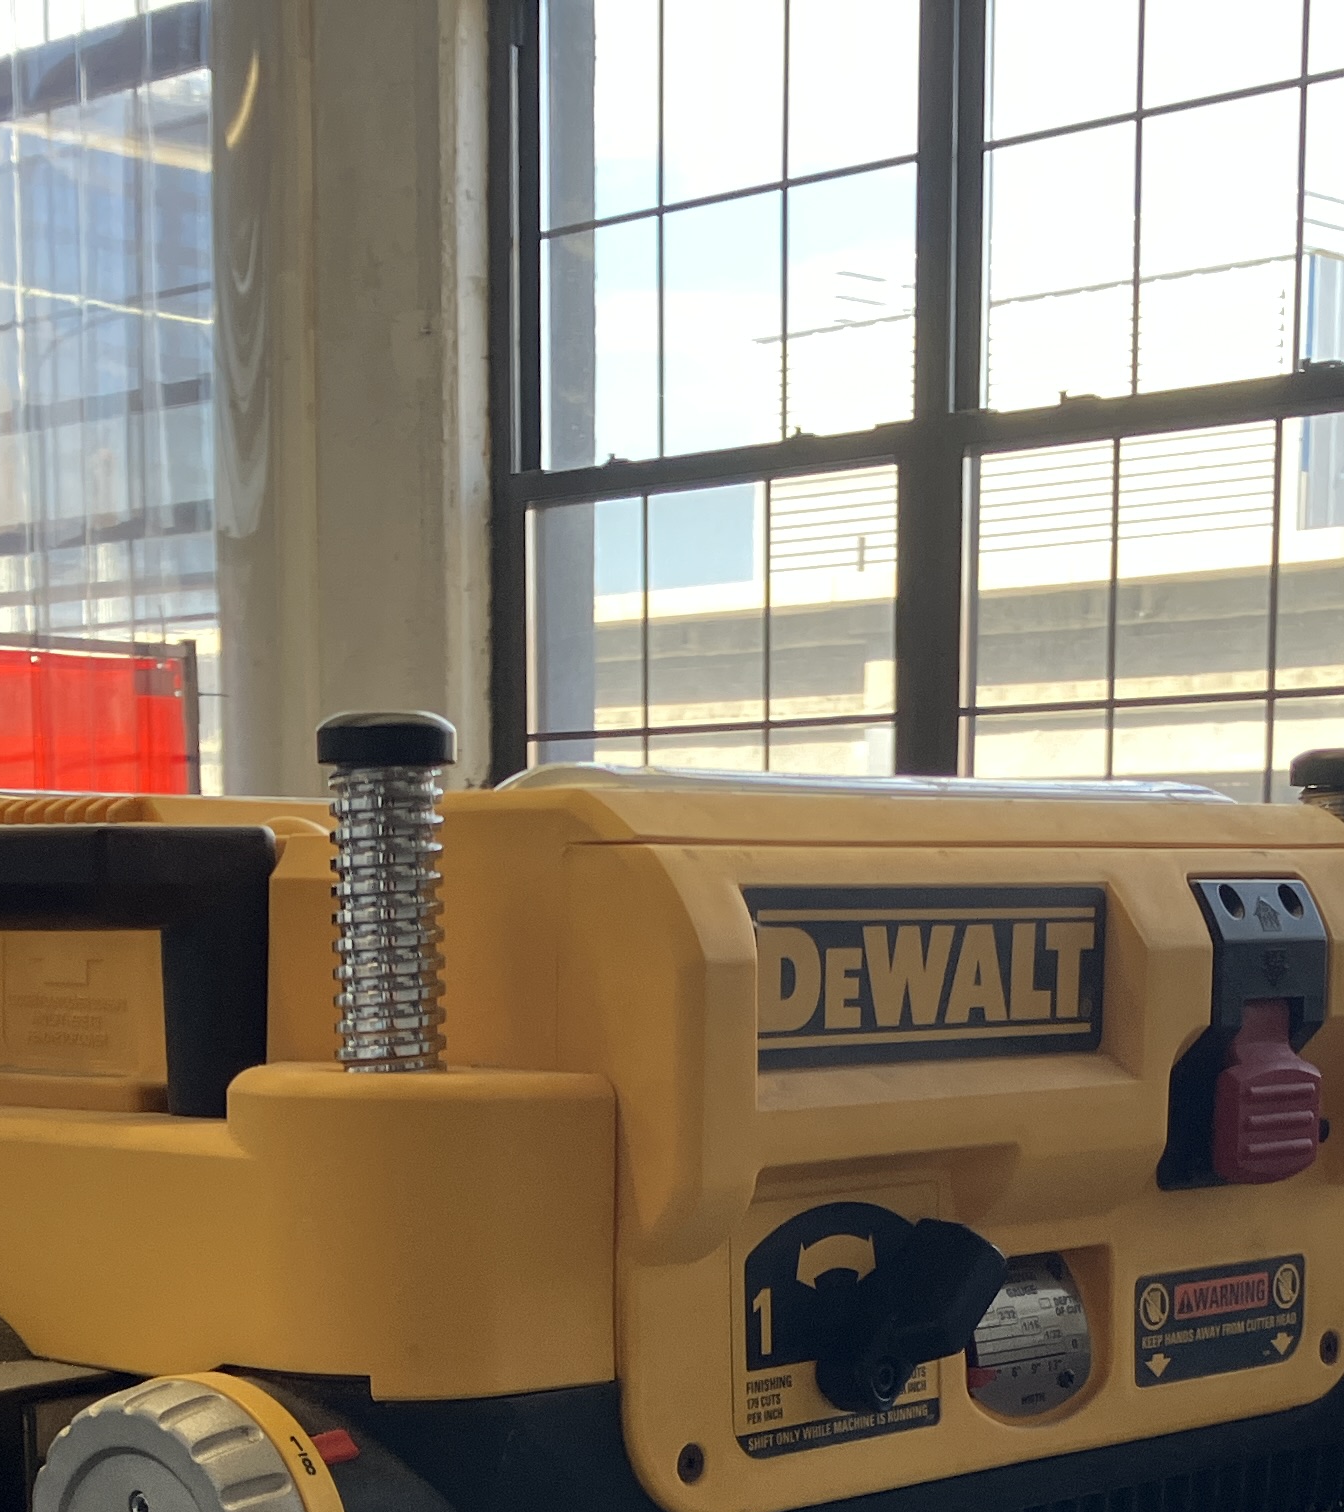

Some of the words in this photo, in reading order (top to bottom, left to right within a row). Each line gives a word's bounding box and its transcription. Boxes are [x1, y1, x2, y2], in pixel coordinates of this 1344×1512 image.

[1193, 1279, 1266, 1312] WARNING
[753, 1288, 772, 1355] 1
[1142, 1335, 1163, 1349] KEEP
[1165, 1329, 1195, 1346] HANDS
[1196, 1325, 1220, 1341] AWAY
[1222, 1320, 1245, 1336] FROM
[1246, 1316, 1275, 1333] CUTTER
[746, 1375, 793, 1395] FINISHING
[761, 1393, 781, 1408] CUTS
[747, 1411, 762, 1424] PER
[764, 1407, 783, 1421] INCH
[748, 1435, 774, 1451] SHIFT
[776, 1430, 800, 1446] ONLY
[802, 1425, 831, 1441] WHILE
[833, 1416, 875, 1433] MACHINE
[877, 1413, 886, 1426] IS
[888, 1404, 928, 1423] RUNNING
